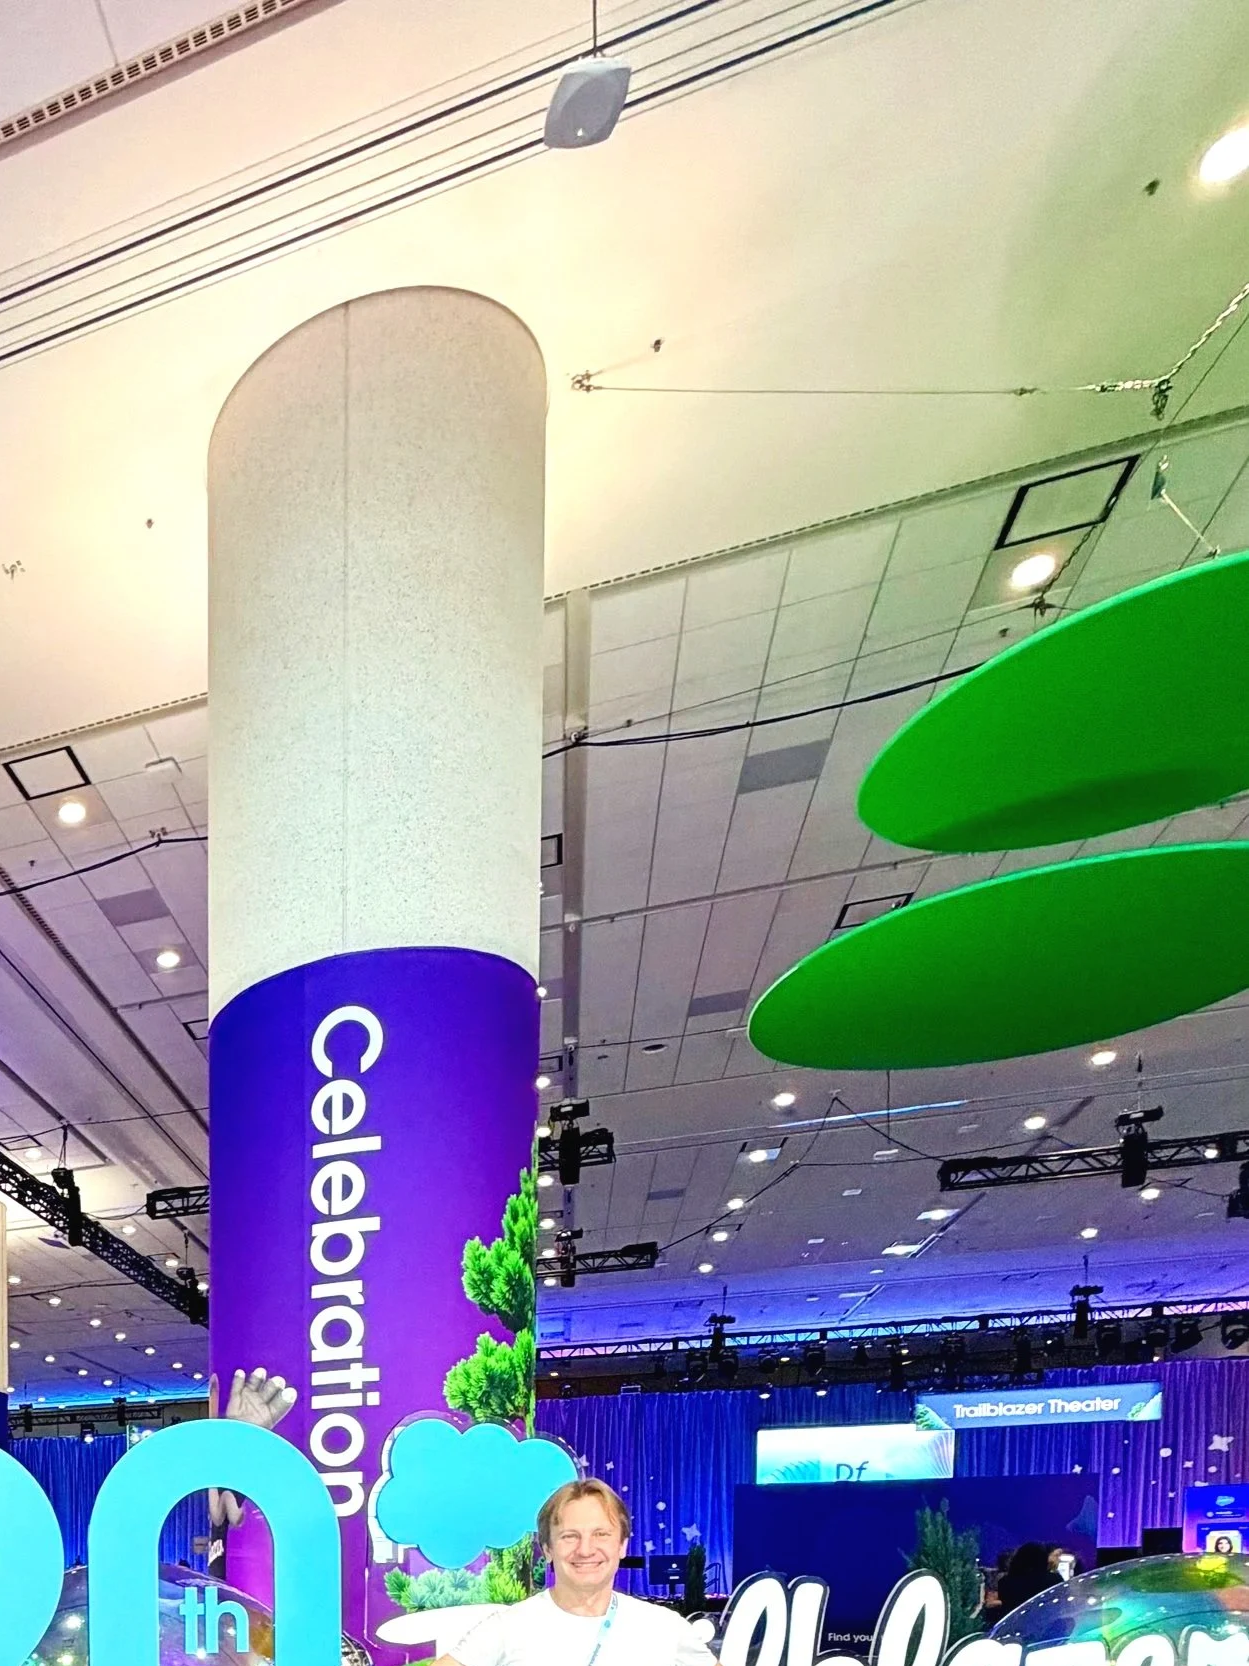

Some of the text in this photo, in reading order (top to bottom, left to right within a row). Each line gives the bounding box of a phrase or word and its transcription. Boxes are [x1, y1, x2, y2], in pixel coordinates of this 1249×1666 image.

[310, 1005, 384, 1517] Celebration
[953, 1397, 1121, 1419] Trailblazer Theater
[178, 1585, 250, 1655] th
[827, 1632, 851, 1642] Find
